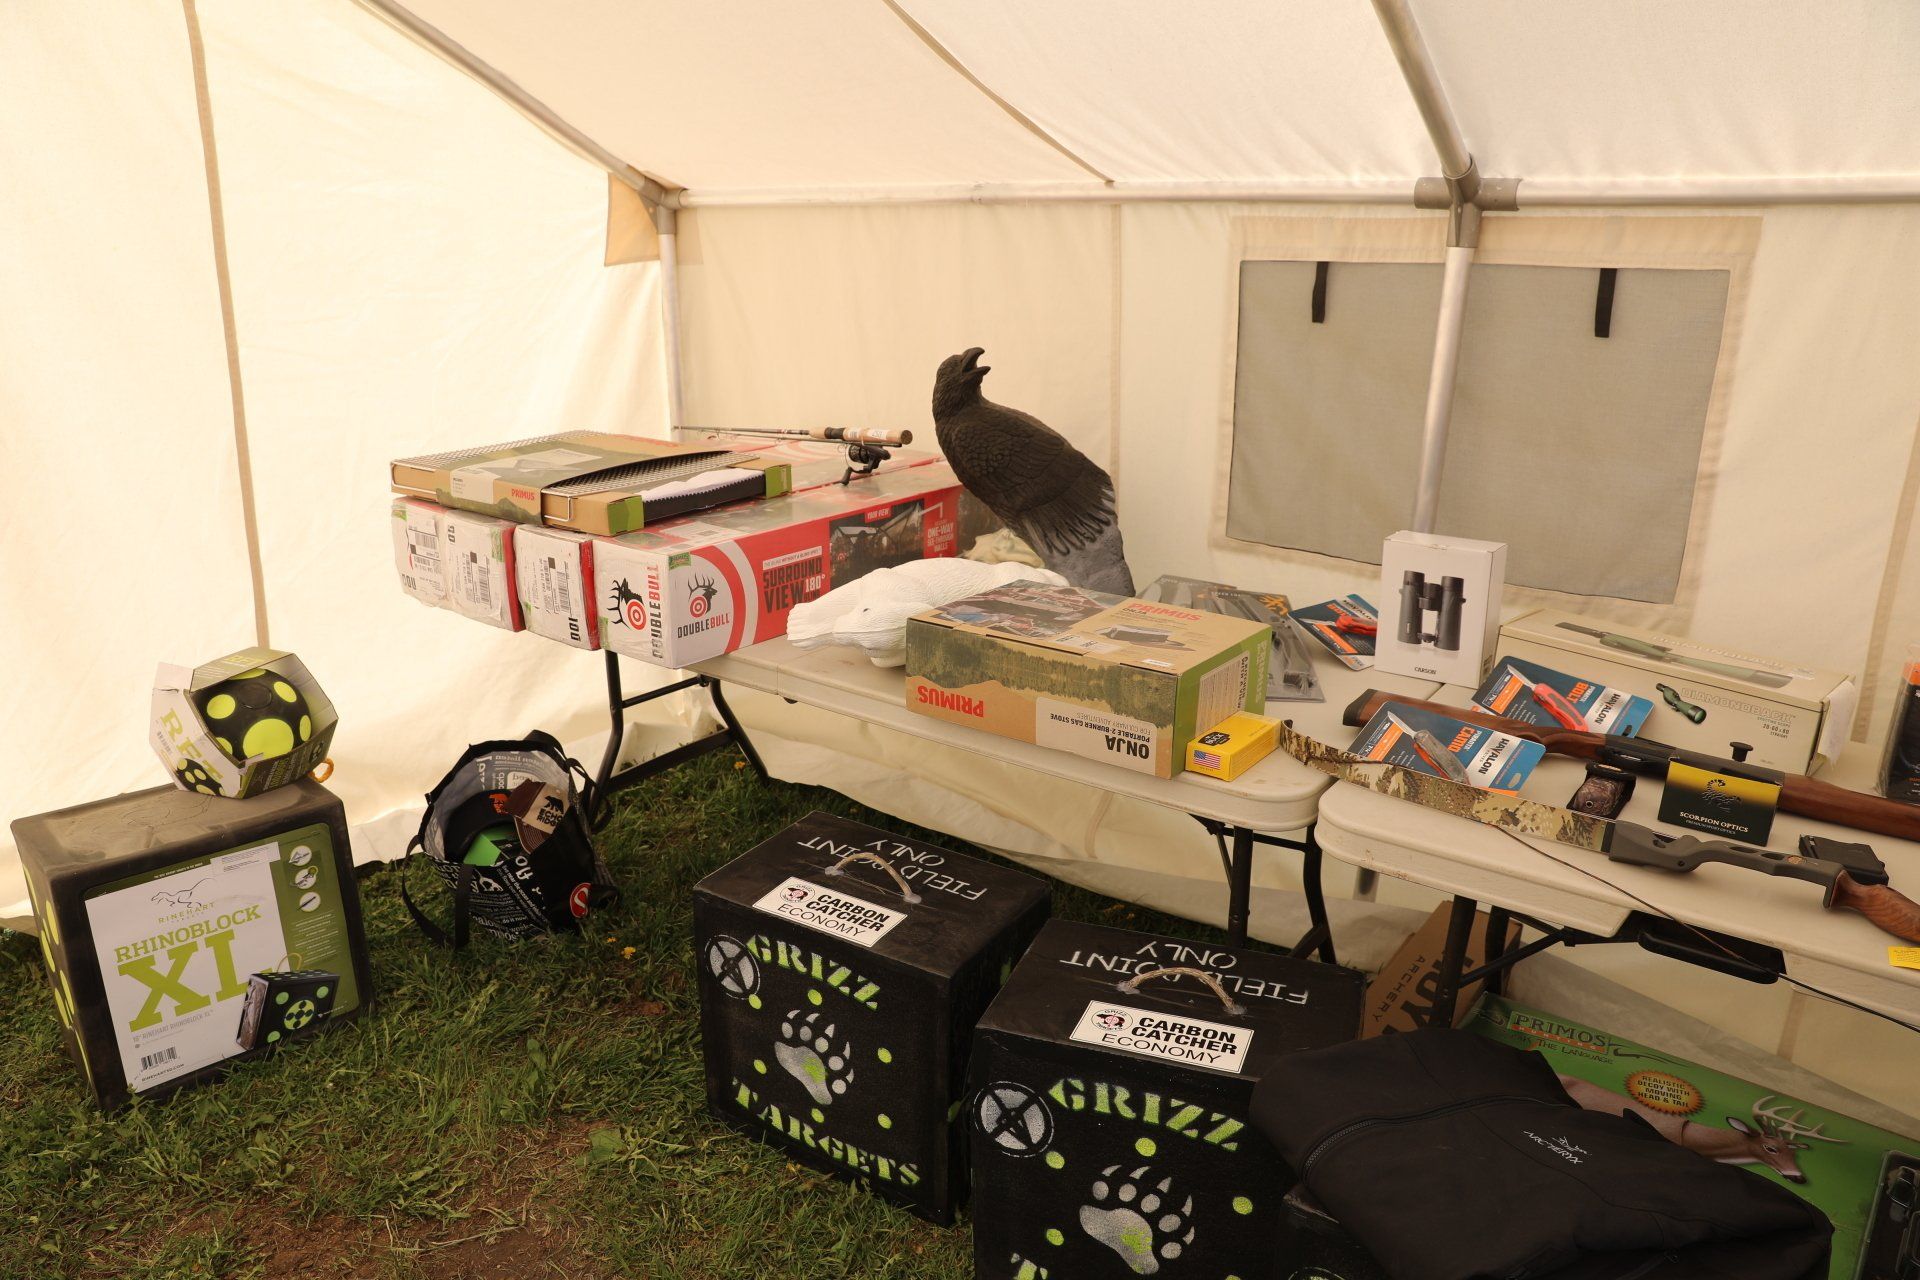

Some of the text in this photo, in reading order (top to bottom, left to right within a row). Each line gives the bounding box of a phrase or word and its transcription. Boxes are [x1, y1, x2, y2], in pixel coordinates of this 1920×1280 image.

[511, 488, 535, 500] PRIMUS
[927, 522, 953, 537] ONE-WAY
[763, 557, 823, 591] SURROUND
[647, 564, 664, 658] DOUBLEBULL
[764, 583, 806, 614] VIEW
[1128, 603, 1202, 621] PRIMUS
[677, 612, 730, 639] DOUBLEBULL
[1414, 666, 1437, 675] CARSON
[918, 685, 984, 718] PRIMUS
[1595, 693, 1621, 725] HAVALON
[1050, 712, 1150, 742] PORTABLE 2-BURNER GAS STOVE
[1076, 712, 1150, 735] FOR CULINARY ADVENTURES
[1105, 735, 1150, 760] ONJA
[1478, 738, 1510, 774] HAVALON
[537, 815, 557, 827] RIDG
[1680, 811, 1749, 833] SCORPION OPTICS
[866, 839, 945, 867] ONLY
[899, 863, 988, 900] FIELD
[158, 902, 216, 924] RINEHART
[777, 903, 865, 937] ECONOMY
[806, 901, 885, 931] CATCHER
[818, 894, 890, 923] CARBON
[114, 904, 262, 963] RHINOBLOCK
[1136, 940, 1237, 969] ONLY
[117, 929, 272, 1032] XL
[746, 934, 881, 1010] GRIZZ
[1200, 970, 1309, 1005] FIELD
[1373, 955, 1425, 1022] ARCHERY
[142, 1025, 170, 1040] RINEHART
[1131, 1026, 1238, 1055] CATCHER
[1138, 1016, 1236, 1044] CARBON
[1515, 1014, 1606, 1047] PRIMOS
[1519, 1026, 1596, 1050] HUNTING
[1101, 1033, 1222, 1064] ECONOMY
[1536, 1037, 1557, 1050] THE
[1561, 1046, 1614, 1064] LANGUAGE
[1637, 1080, 1690, 1096] DECOY WITH
[1642, 1075, 1686, 1090] REALISTIC
[1645, 1088, 1682, 1101] MOVING
[1637, 1091, 1689, 1108] HEAD & TAIL
[1048, 1078, 1245, 1152] GRIZZ
[732, 1076, 921, 1186] TARGETS
